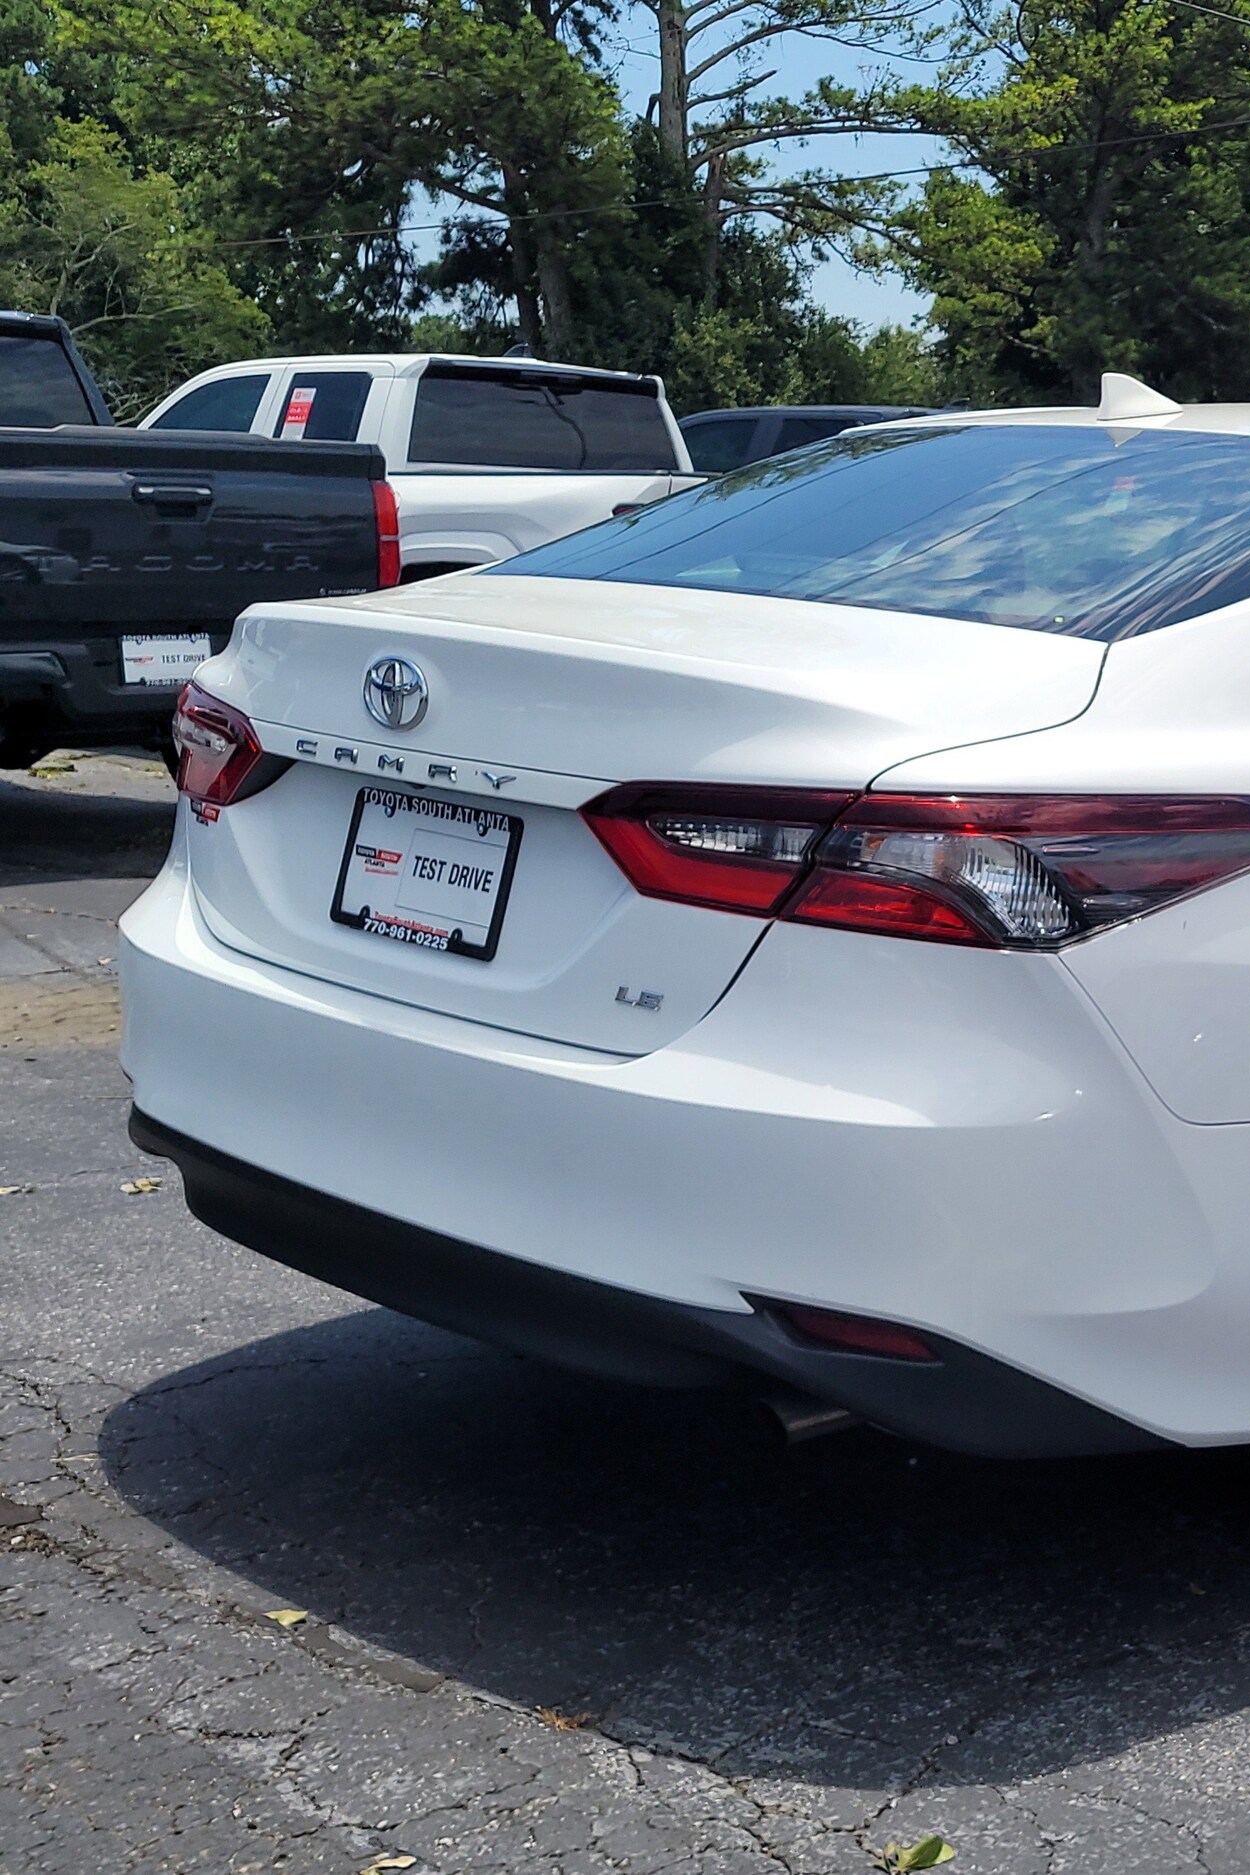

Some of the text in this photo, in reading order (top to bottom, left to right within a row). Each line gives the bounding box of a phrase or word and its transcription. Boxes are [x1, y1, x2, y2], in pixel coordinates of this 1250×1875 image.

[23, 555, 320, 572] TACOMA
[162, 654, 181, 664] TEST
[296, 739, 517, 790] CAMRY
[362, 787, 510, 832] TOYOTA SOUTH ATLANTA
[412, 855, 494, 893] TEST DRIVE
[614, 986, 664, 1012] LE
